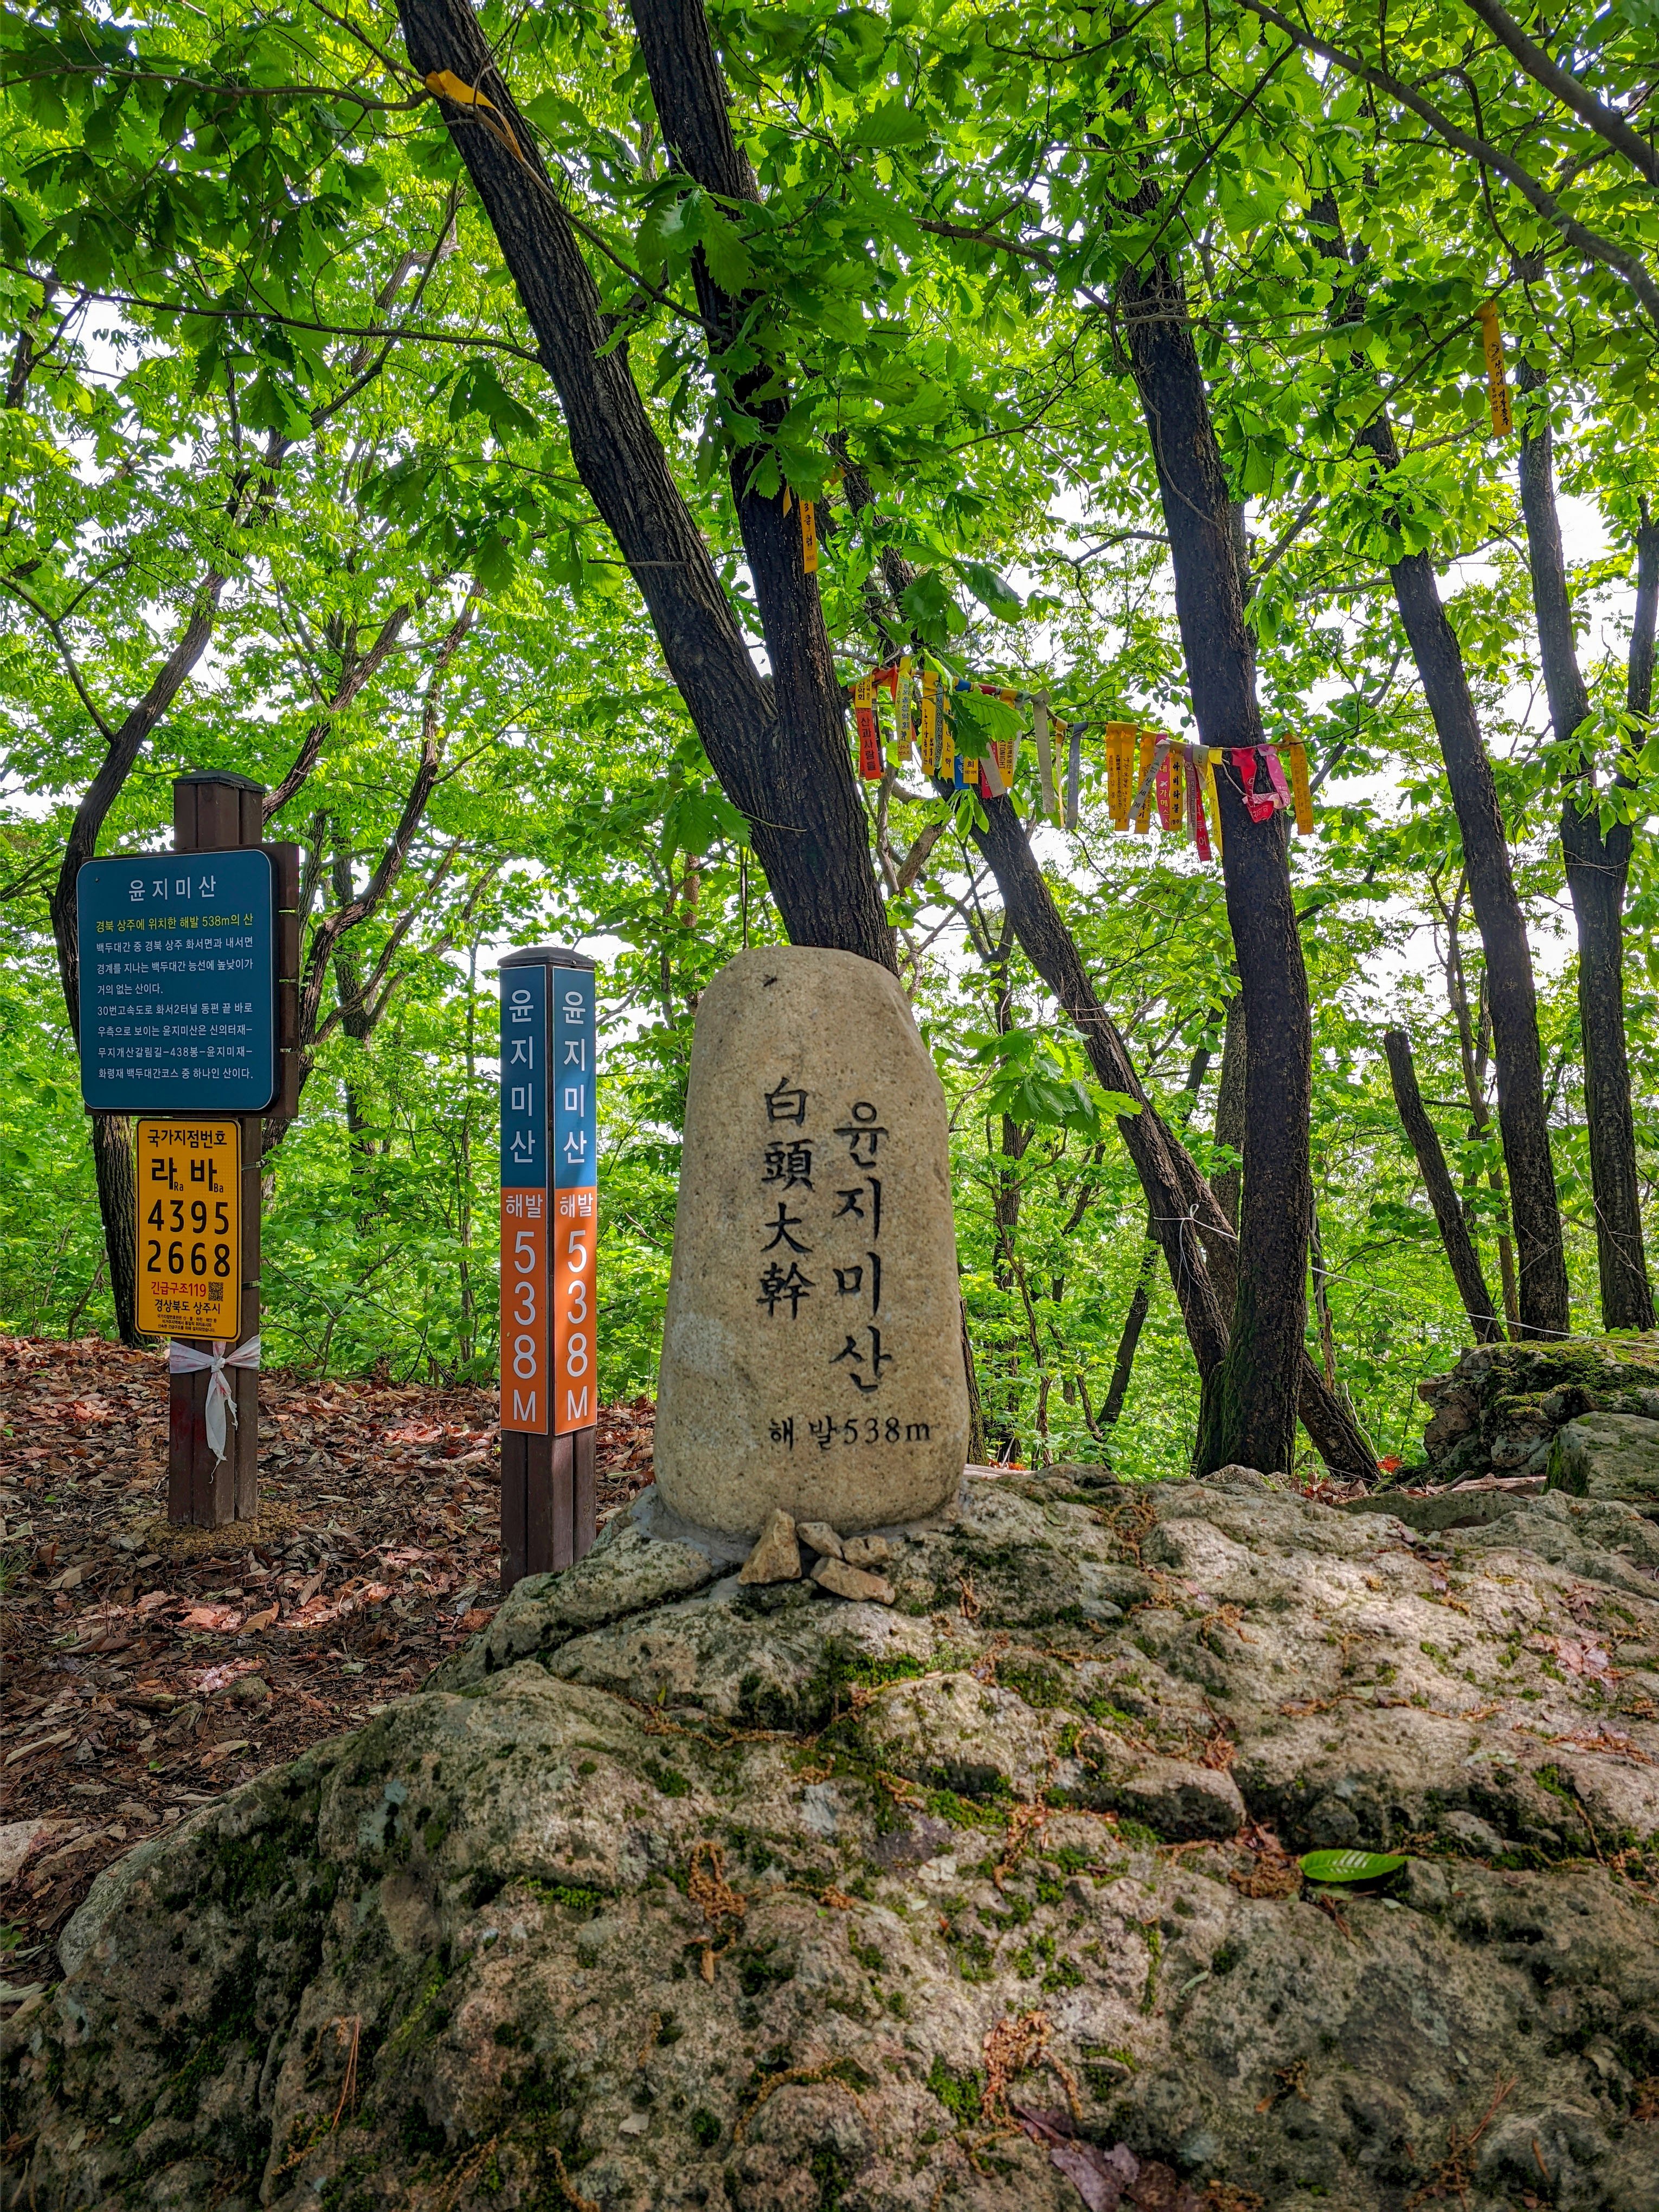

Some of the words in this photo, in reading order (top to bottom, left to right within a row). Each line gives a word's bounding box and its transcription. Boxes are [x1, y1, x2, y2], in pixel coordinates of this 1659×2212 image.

[128, 875, 216, 902] 윤지미산
[96, 921, 114, 933] 경북
[117, 918, 145, 932] 상주에
[148, 916, 176, 930] 위치한
[179, 916, 198, 928] 해발
[202, 914, 240, 927] 538m의
[243, 913, 253, 925] 산
[97, 941, 130, 953] 백두대간
[133, 941, 142, 952] 중
[145, 940, 162, 951] 경북
[165, 939, 183, 950] 상주
[185, 937, 222, 950] 화서면과
[226, 936, 253, 948] 내서면
[97, 963, 121, 974] 경계를
[124, 962, 149, 974] 지나는
[152, 960, 185, 973] 백두대간
[188, 960, 214, 970] 능선에
[217, 959, 253, 970] 높낮이가
[98, 985, 113, 995] 거의
[116, 983, 132, 994] 없는
[135, 983, 163, 994] 산이다.
[98, 1005, 153, 1016] 30번고속도로
[156, 1004, 197, 1015] 화서2터널
[201, 1003, 218, 1014] 동편
[222, 1003, 231, 1014] 끝
[234, 1002, 253, 1013] 바로
[98, 1026, 131, 1037] 우측으로
[134, 1026, 159, 1037] 보이는
[163, 1025, 206, 1036] 윤지미산은
[99, 1068, 124, 1079] 화령재
[181, 1068, 190, 1079] 중
[193, 1068, 219, 1079] 하나인
[223, 1068, 253, 1079] 산이다.
[509, 989, 535, 1163] 윤지미산
[562, 991, 587, 1163] 윤지미산
[147, 1129, 227, 1148] 국가지점번호
[152, 1157, 177, 1190] 라
[191, 1159, 217, 1191] 바
[506, 1194, 543, 1219] 해발
[560, 1193, 593, 1218] 해발
[756, 1077, 815, 1321] 白頭大幹
[147, 1199, 229, 1235] 4395
[828, 1102, 892, 1392] 윤지미산
[147, 1240, 230, 1277] 2668
[151, 1282, 206, 1297] 긴급구조119
[155, 1299, 190, 1313] 경상북도
[193, 1302, 220, 1315] 상주시
